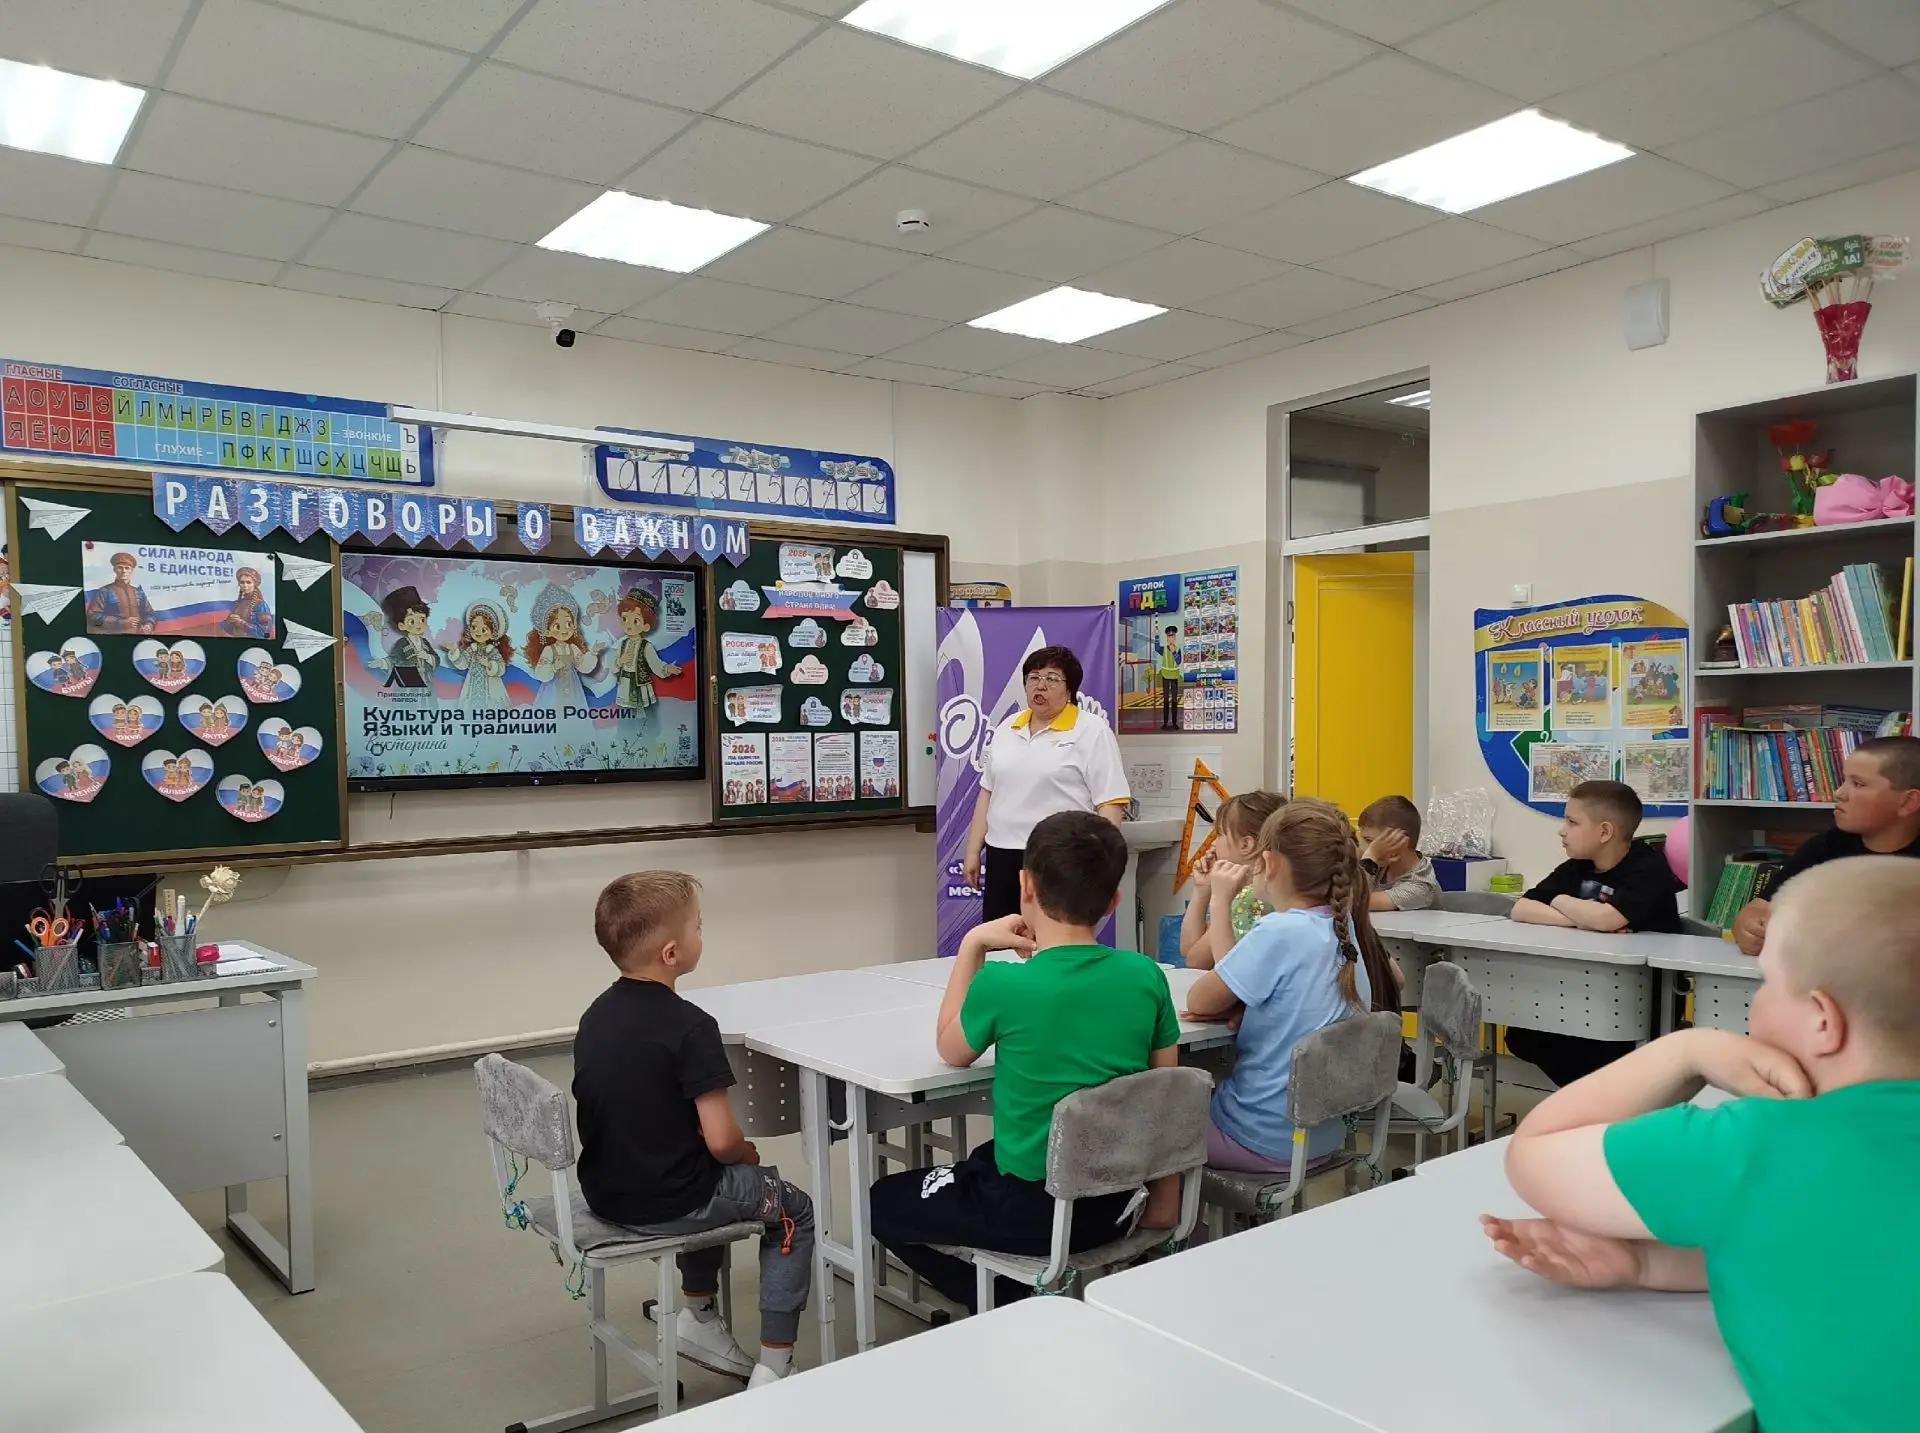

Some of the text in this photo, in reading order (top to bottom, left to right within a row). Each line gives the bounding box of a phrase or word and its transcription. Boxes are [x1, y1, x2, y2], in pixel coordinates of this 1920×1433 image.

[5, 364, 62, 380] ГЛАСНЫЕ
[113, 376, 183, 393] СОГЛАСНЫЕ
[342, 429, 393, 443] ЗВОНКИЕ
[155, 443, 203, 457] ГЛУХИЕ
[165, 480, 747, 555] РАЗГОВОРЫ О ВАЖНОМ
[138, 546, 234, 563] СИЛА НАРОДА
[148, 563, 156, 573] В
[160, 563, 234, 577] ЕДИНСТВЕ!
[1132, 580, 1165, 592] УГОЛОК
[785, 601, 813, 609] СТРАНА
[1128, 589, 1168, 611] ПДД
[1488, 606, 1644, 641] Классный уголок
[377, 691, 432, 699] Пришкольный
[363, 705, 637, 724] Культура народов России.
[363, 721, 557, 738] Языки и традиции
[732, 744, 756, 754] 2026
